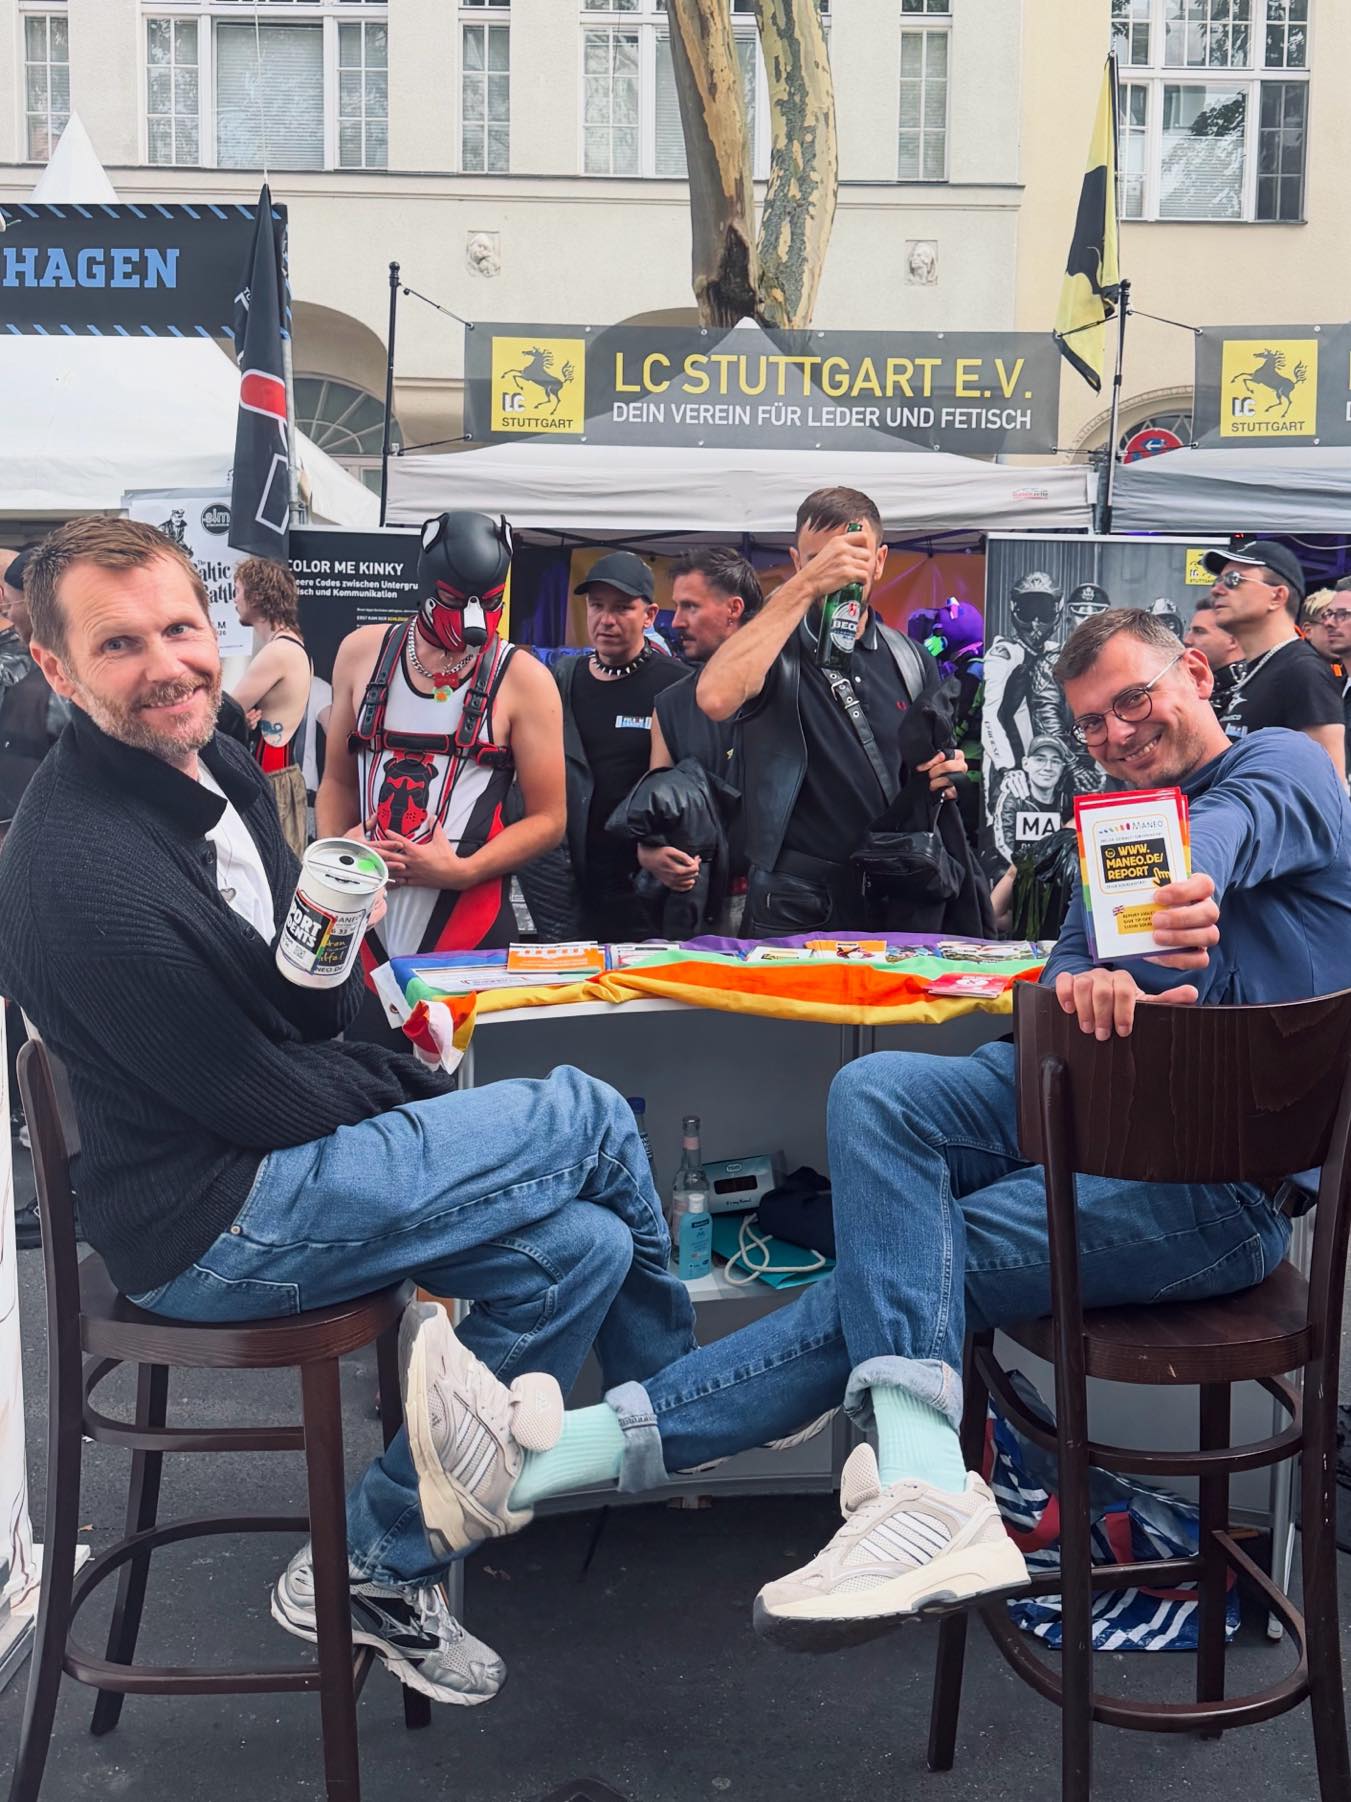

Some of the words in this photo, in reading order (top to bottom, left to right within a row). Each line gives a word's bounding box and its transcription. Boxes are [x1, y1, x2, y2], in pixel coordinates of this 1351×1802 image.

[3, 248, 180, 289] HAGEN
[615, 352, 670, 394] LC
[681, 354, 942, 397] STUTTGART
[955, 358, 1032, 398] E.V.
[502, 392, 526, 412] LC
[1232, 397, 1256, 417] LC
[502, 417, 574, 429] STUTTGART
[613, 402, 664, 423] DEIN
[671, 404, 750, 425] VEREIN
[758, 402, 801, 426] FÜR
[808, 406, 880, 427] LEDER
[886, 408, 934, 428] UND
[941, 408, 1032, 429] FETISCH
[1231, 421, 1305, 433] STUTTGART
[193, 561, 231, 582] altic
[335, 561, 356, 574] ME
[360, 562, 404, 576] KINKY
[316, 579, 341, 588] Codes
[342, 580, 380, 589] zwischen
[316, 588, 331, 596] und
[333, 588, 398, 599] Kommunikation
[1132, 819, 1164, 831] MANEO
[1118, 843, 1150, 857] WWW.
[1106, 852, 1164, 870] MANEO.DE/
[1107, 866, 1149, 881] REPORT
